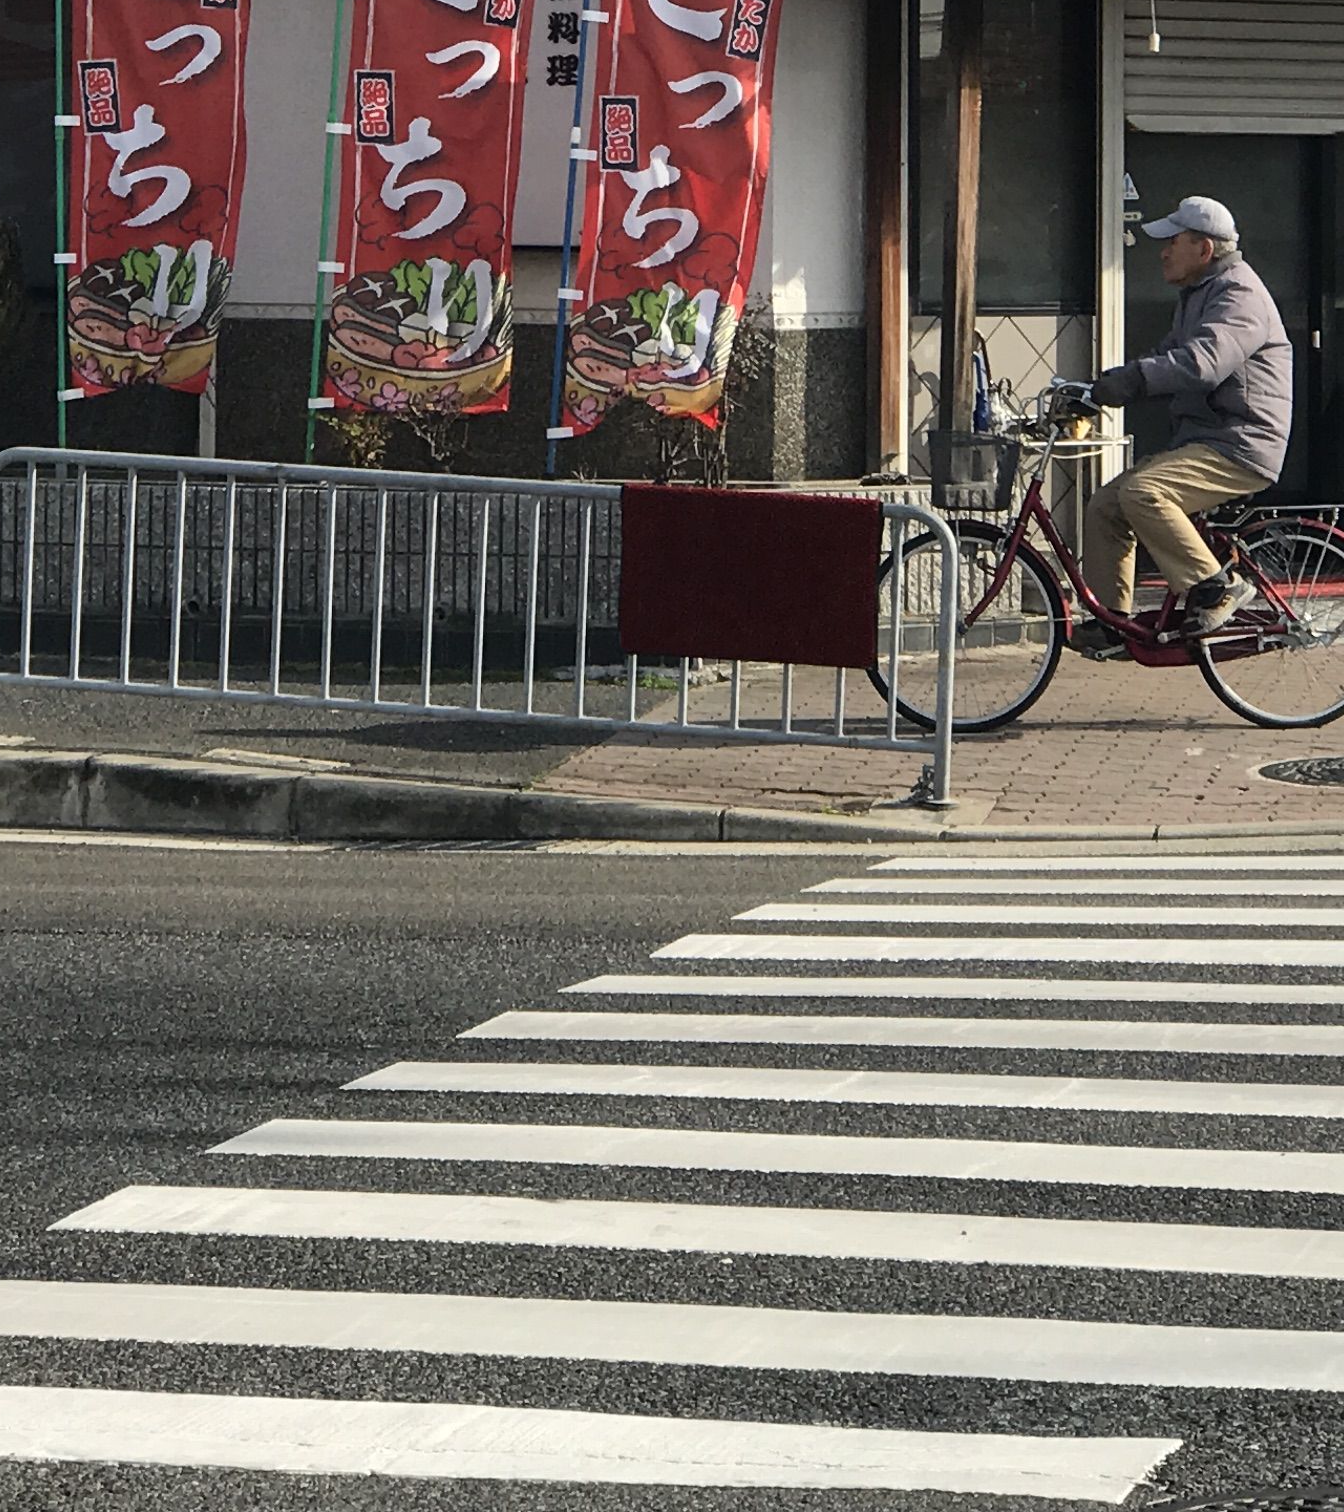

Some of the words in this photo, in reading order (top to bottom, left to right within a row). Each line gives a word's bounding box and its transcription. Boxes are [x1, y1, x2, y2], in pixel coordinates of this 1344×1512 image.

[84, 65, 115, 126] 絶品
[359, 78, 391, 137] 絶品
[606, 104, 635, 166] 絶品
